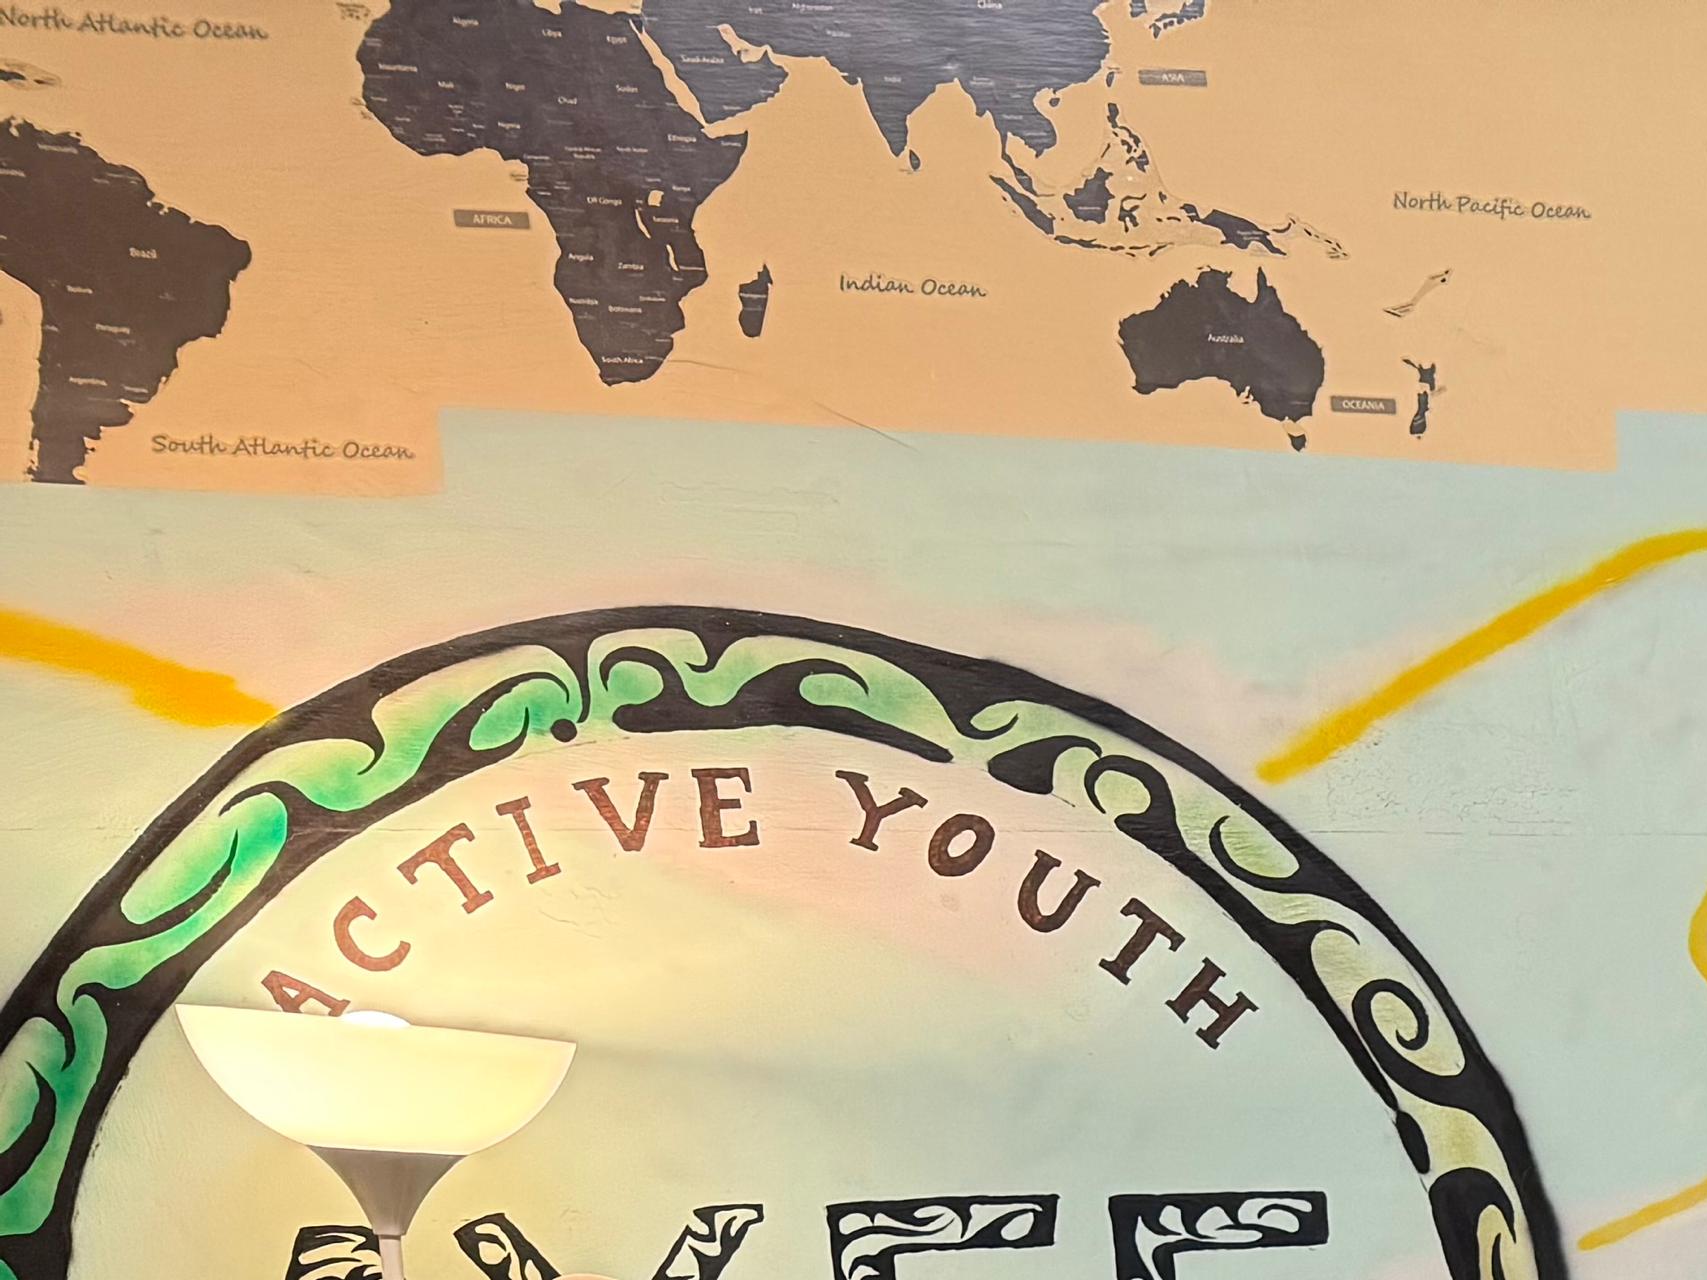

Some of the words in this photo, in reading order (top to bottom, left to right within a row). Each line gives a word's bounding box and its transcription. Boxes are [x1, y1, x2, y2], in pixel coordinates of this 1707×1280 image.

[79, 13, 186, 39] Atlantic
[192, 23, 269, 41] Ocean
[1393, 190, 1452, 213] North
[1456, 194, 1526, 222] Pacific
[1531, 202, 1593, 220] Ocean
[472, 212, 513, 227] AFRICA
[839, 274, 913, 296] Indian
[920, 279, 988, 299] Ocean
[1208, 333, 1245, 345] Australia
[1342, 399, 1386, 412] OCEANIA
[151, 434, 229, 456] South
[232, 438, 335, 460] Atlantic
[340, 442, 416, 461] Ocean
[261, 767, 762, 1017] ACTIVE
[835, 769, 1260, 1050] YOUTH
